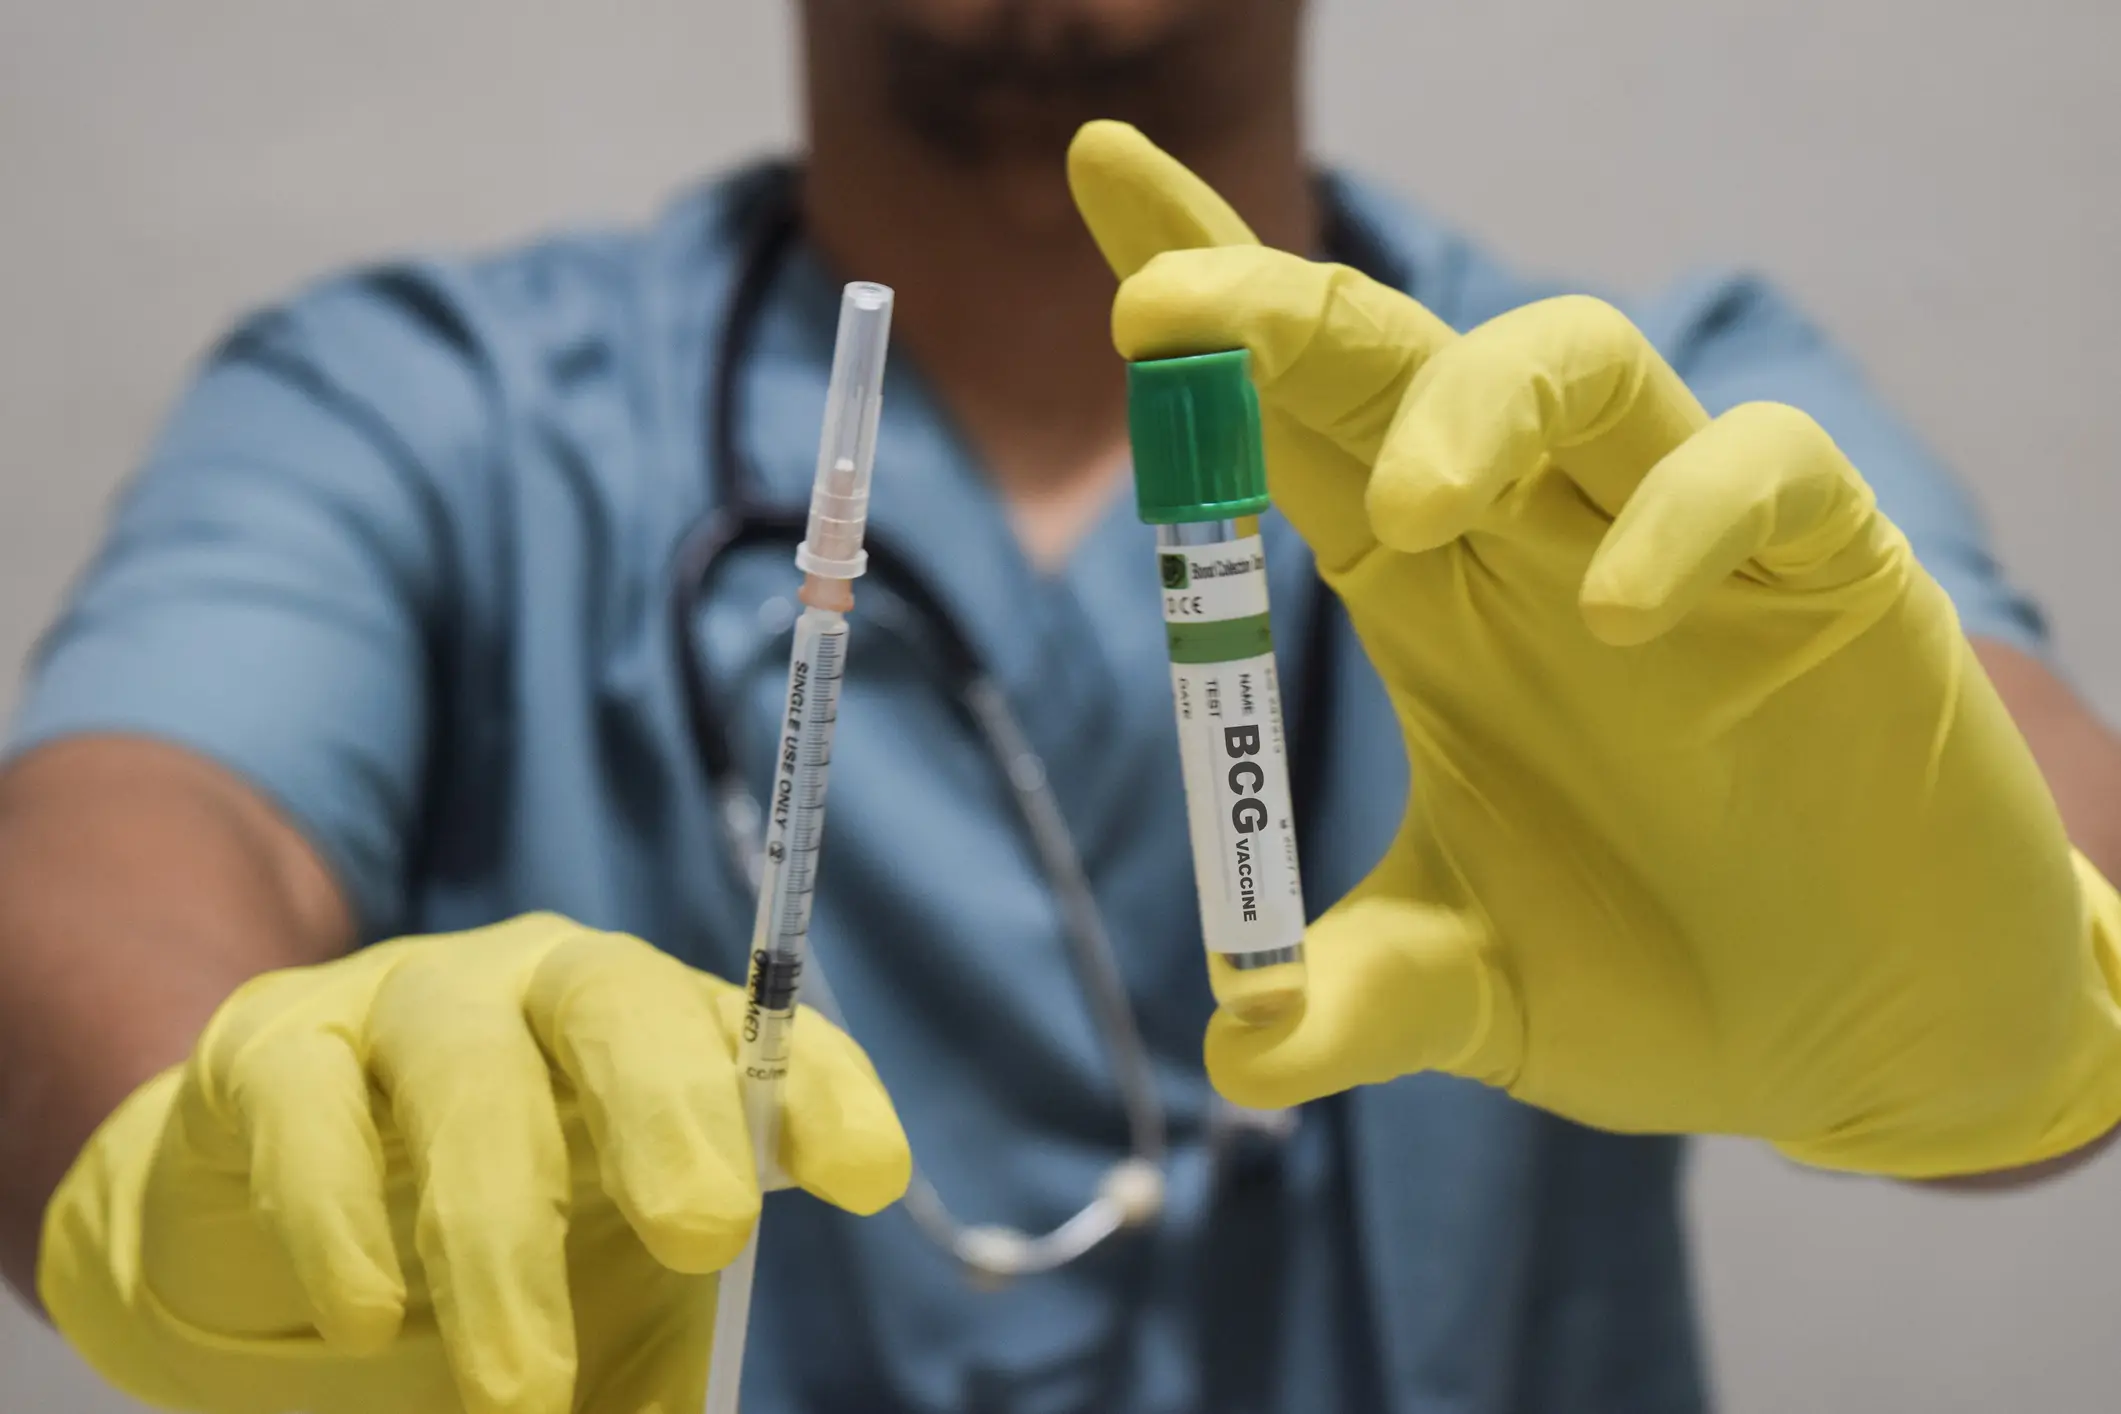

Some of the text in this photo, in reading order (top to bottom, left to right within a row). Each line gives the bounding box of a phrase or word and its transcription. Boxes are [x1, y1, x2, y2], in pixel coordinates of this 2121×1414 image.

[775, 660, 809, 830] SINGLE USE ONLY
[1205, 679, 1221, 718] TEST
[1239, 673, 1255, 717] NAME
[1224, 724, 1267, 922] BCG VACCINE
